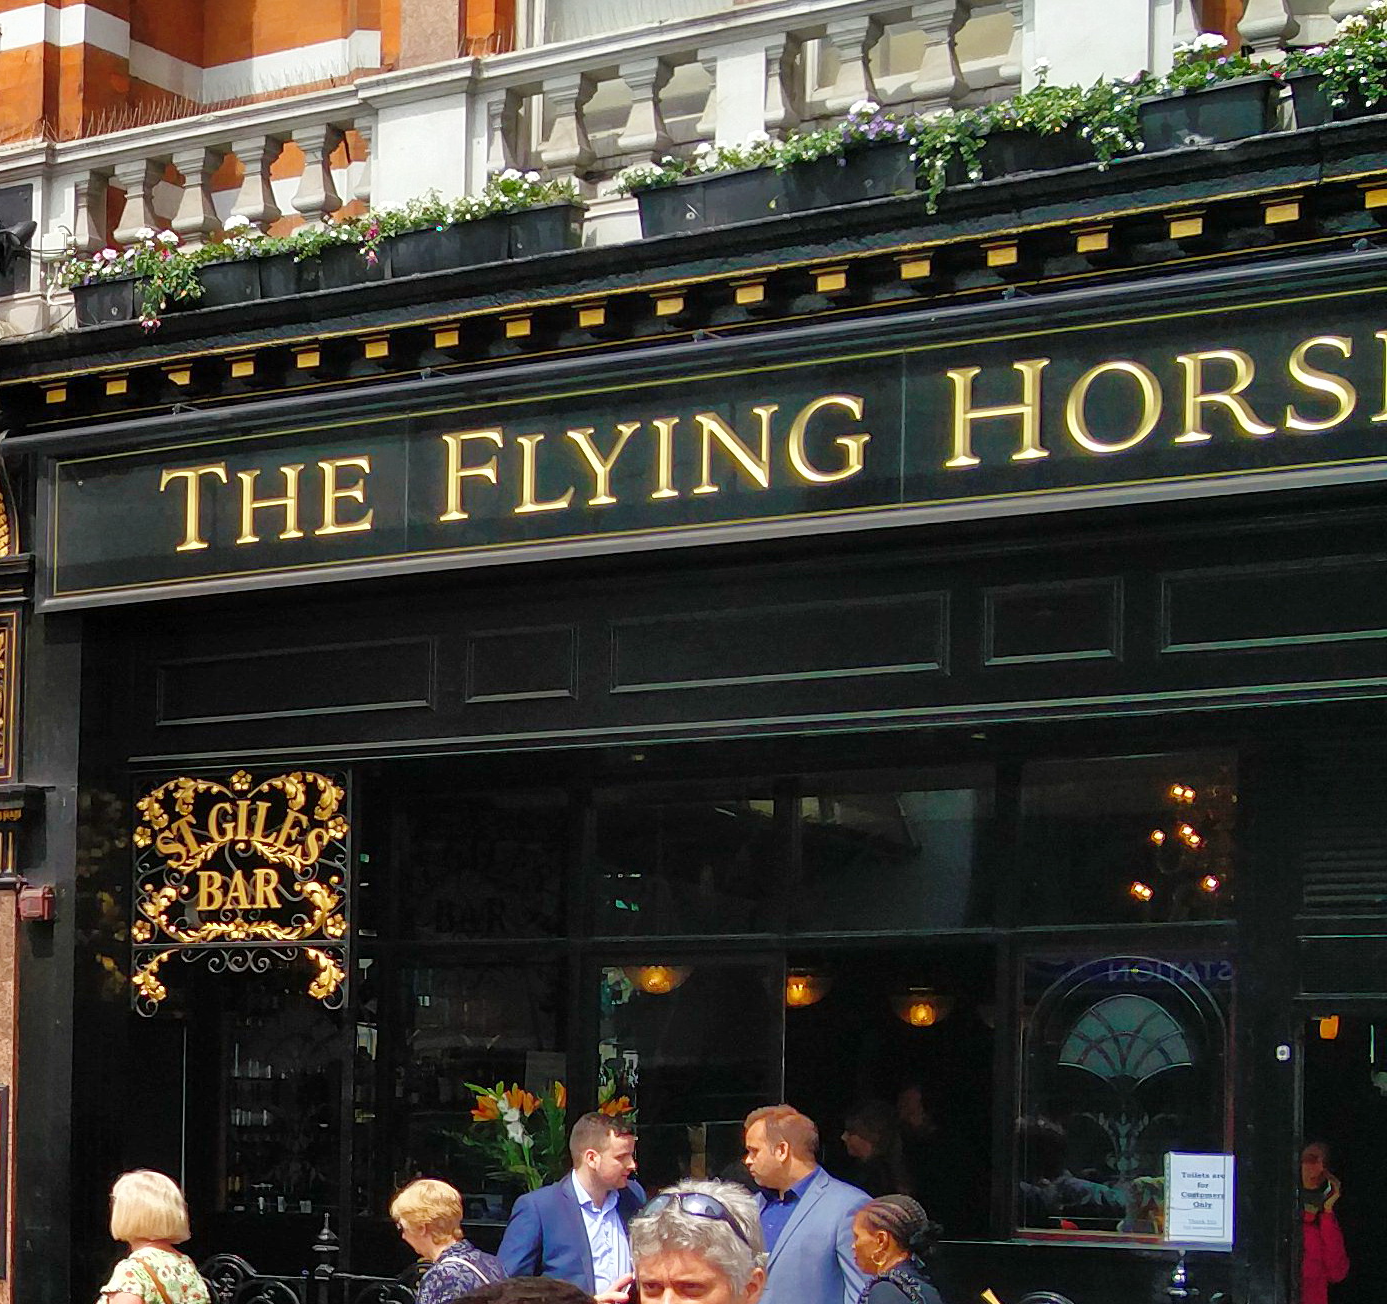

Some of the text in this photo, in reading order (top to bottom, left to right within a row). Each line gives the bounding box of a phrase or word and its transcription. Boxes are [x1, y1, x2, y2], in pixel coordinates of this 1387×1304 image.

[159, 329, 1387, 553] THE FLYING HORS
[155, 800, 328, 869] ST GILES
[195, 868, 283, 911] BAR
[1192, 1201, 1212, 1209] Only
[1197, 1181, 1209, 1189] for
